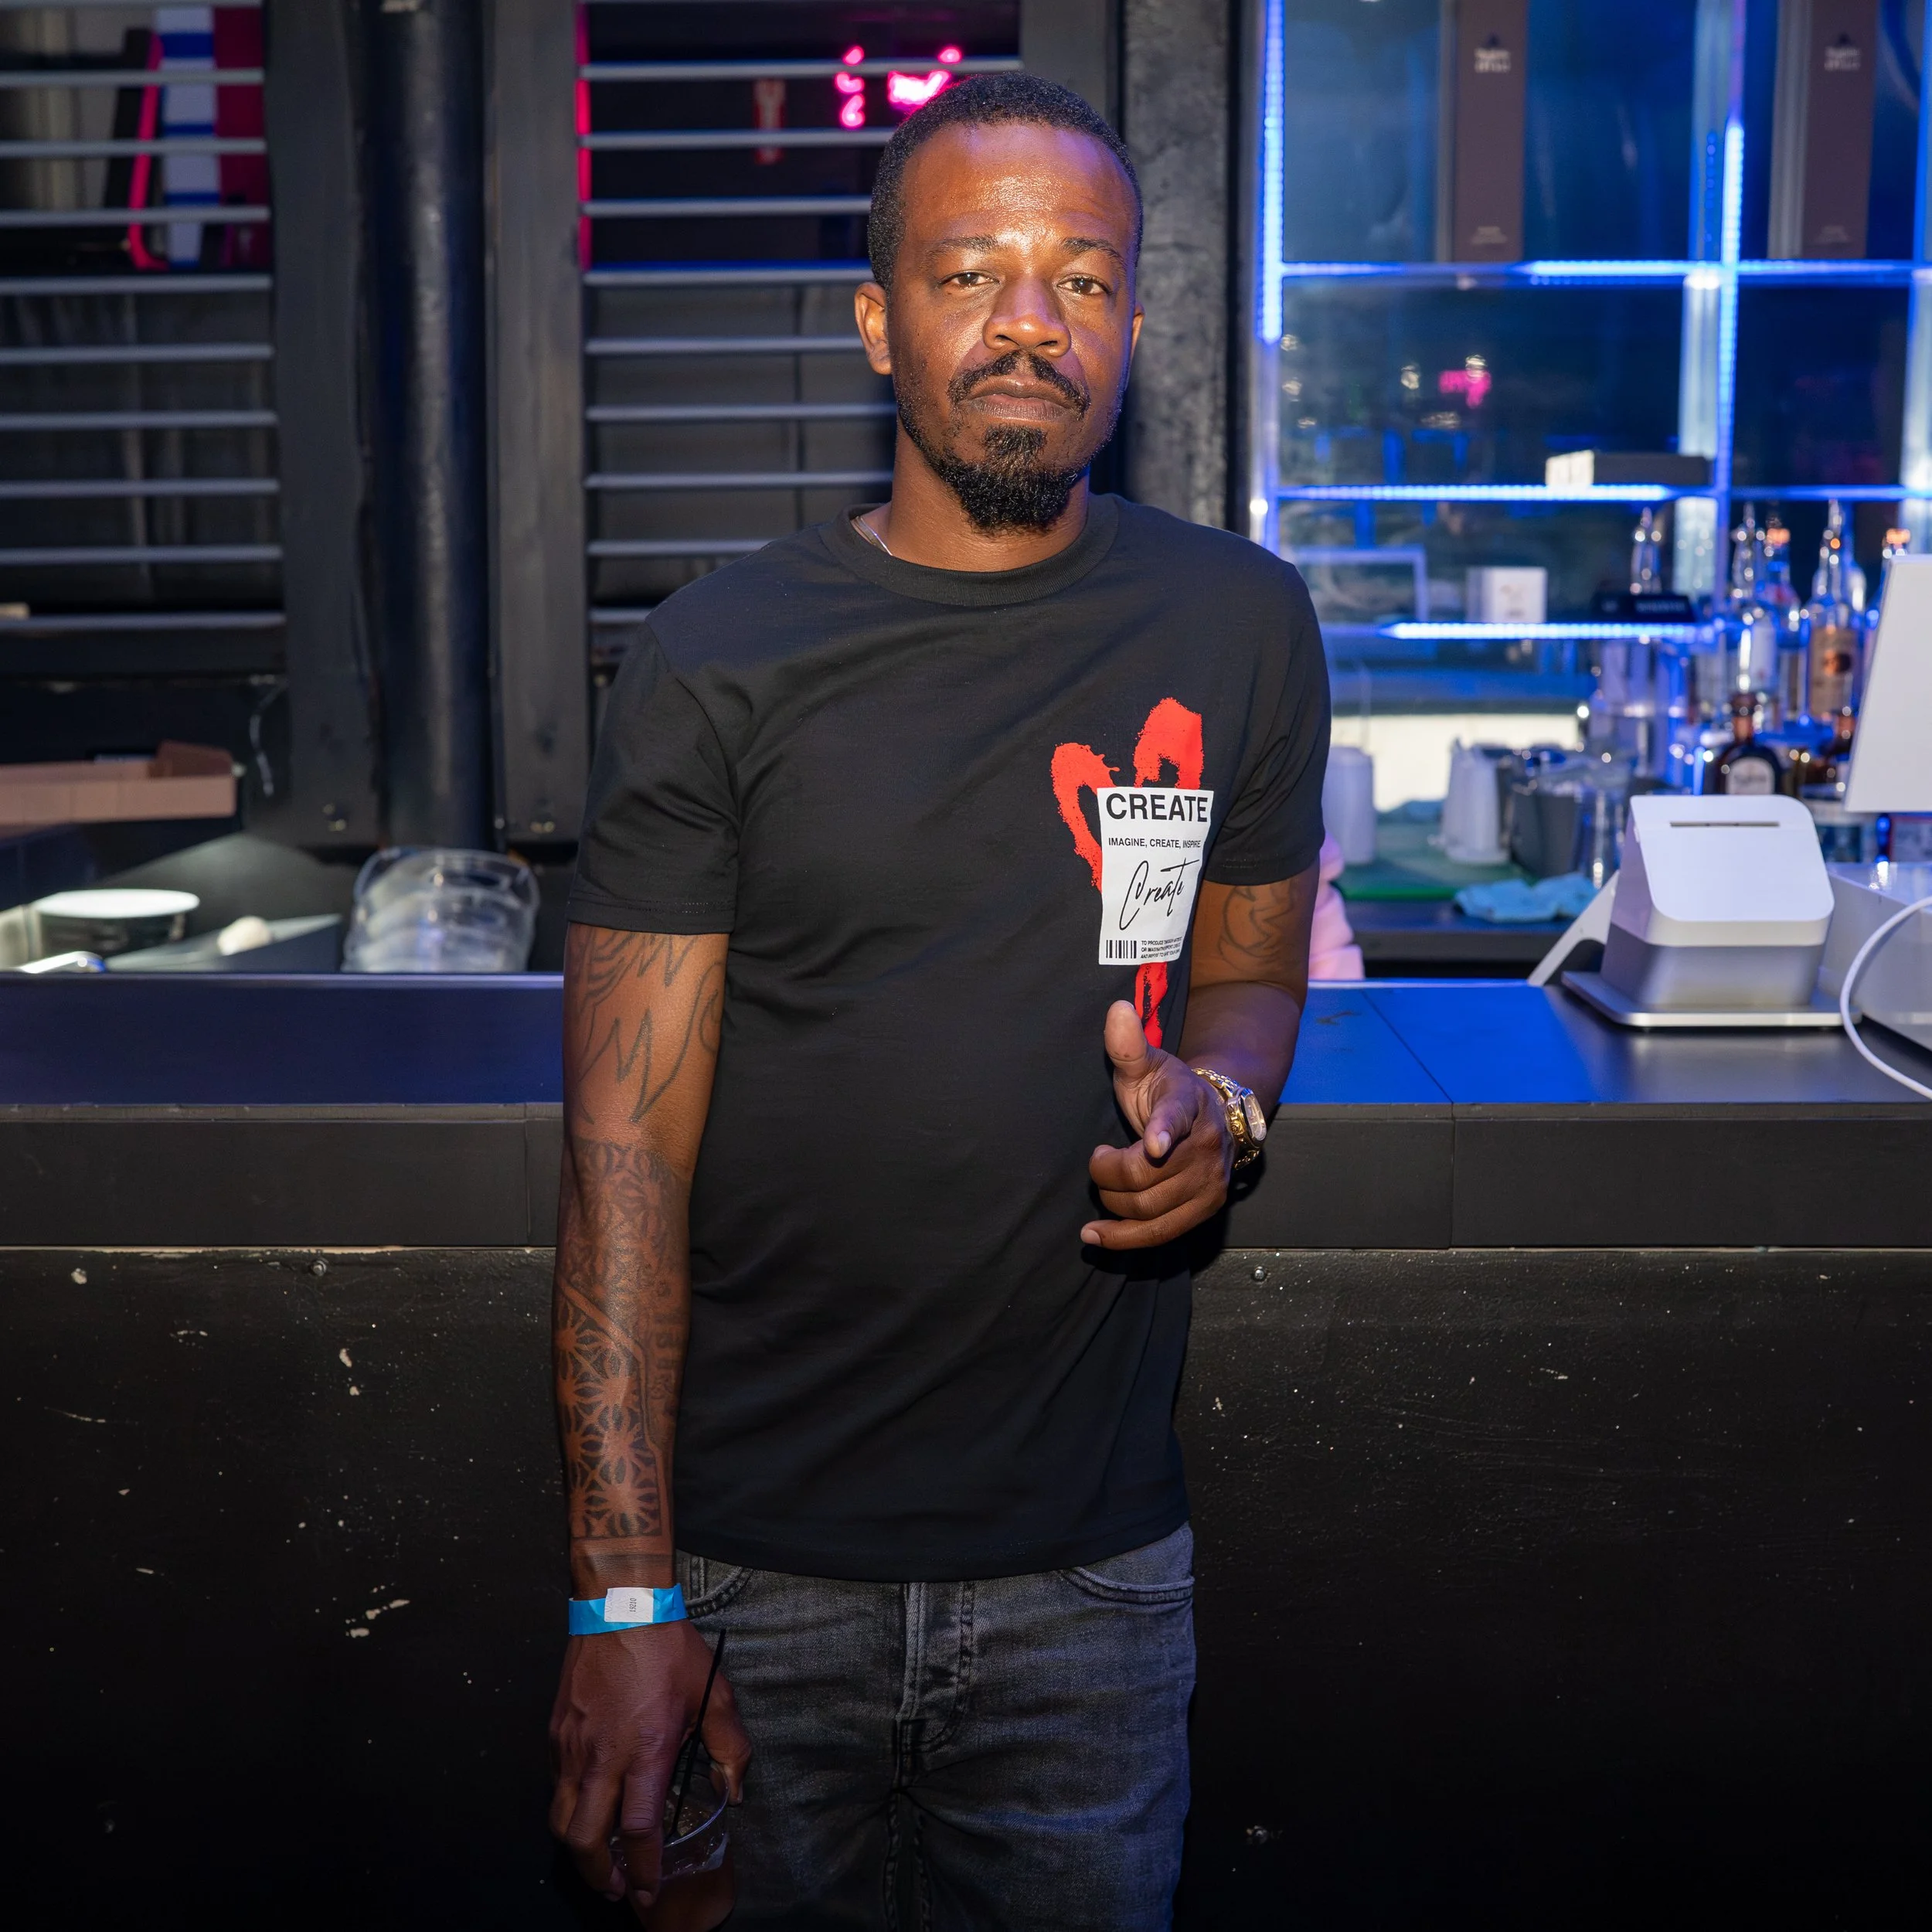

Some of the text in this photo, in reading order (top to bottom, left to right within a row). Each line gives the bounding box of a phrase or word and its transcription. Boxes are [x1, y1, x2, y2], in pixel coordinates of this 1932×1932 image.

[1106, 793, 1208, 822] CREATE
[1108, 838, 1201, 849] IMAGINE, CREATE, INSPIRE
[1119, 857, 1200, 930] Create
